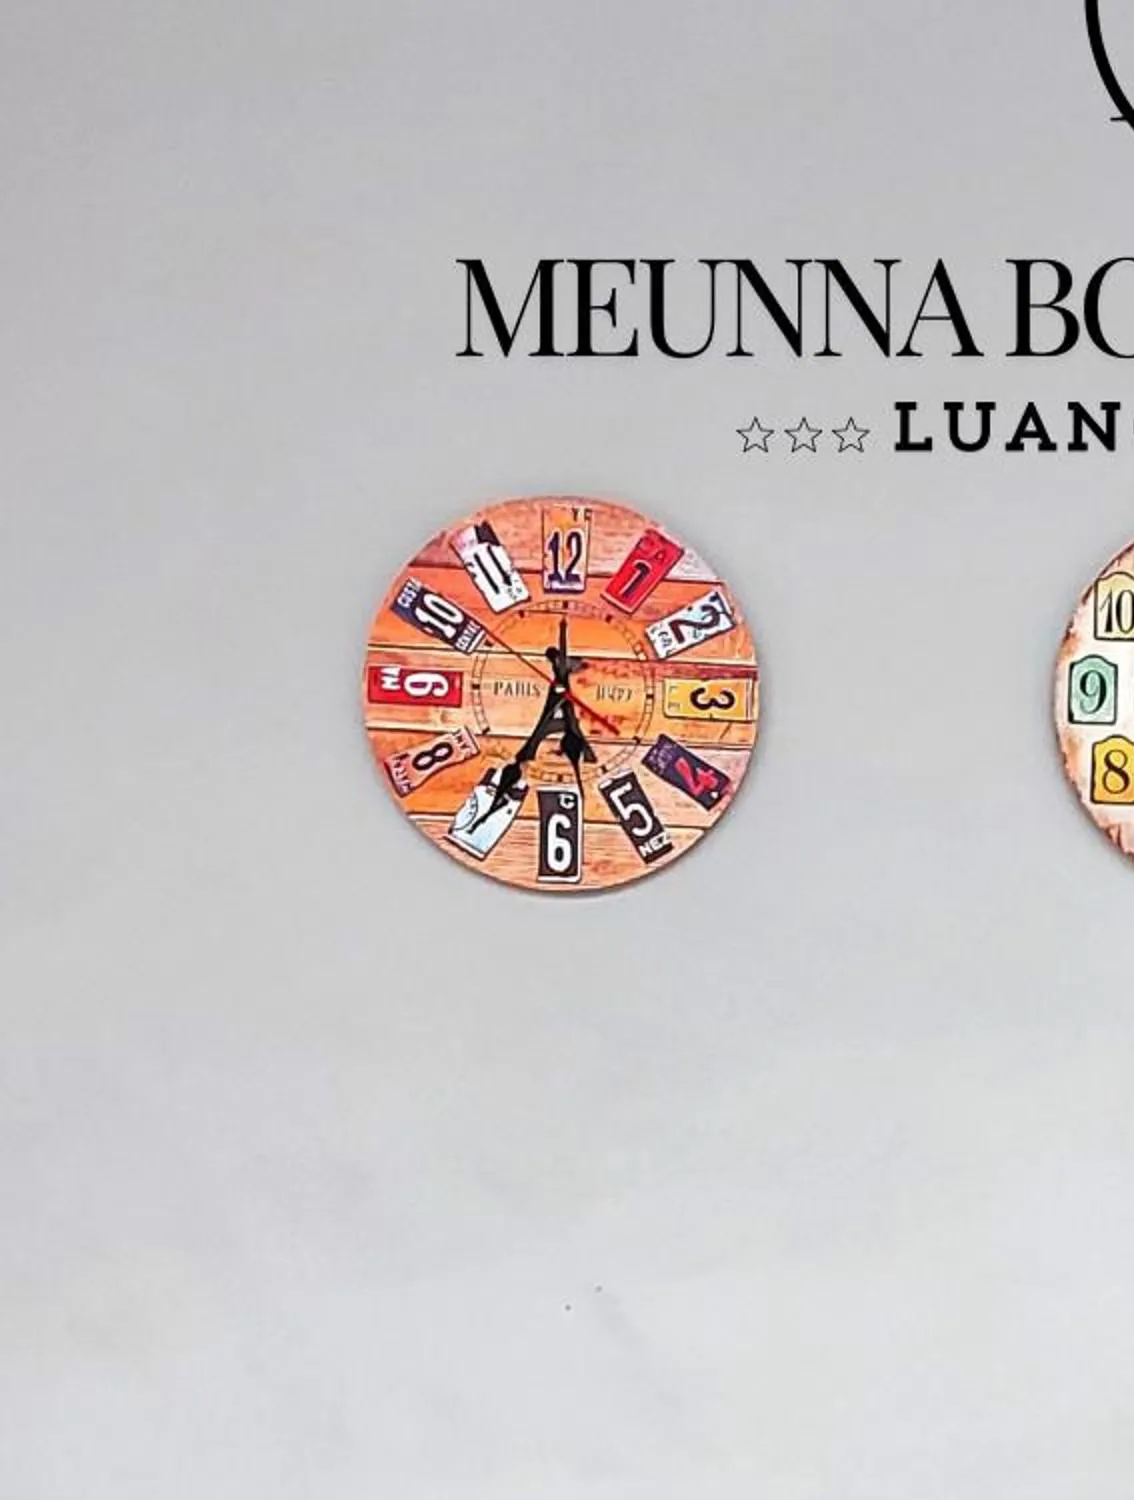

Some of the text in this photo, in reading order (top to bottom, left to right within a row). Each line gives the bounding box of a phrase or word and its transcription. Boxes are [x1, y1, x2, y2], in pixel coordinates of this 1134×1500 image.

[455, 257, 985, 359] MEUNNA
[547, 530, 583, 586] 12
[414, 592, 465, 640] 10
[668, 603, 721, 645] 2
[402, 672, 449, 698] 9
[689, 687, 736, 711] 3
[1079, 669, 1107, 715] 9
[411, 741, 454, 772] 8
[1101, 748, 1130, 794] 8
[608, 781, 653, 838] 5
[546, 813, 573, 872] 6
